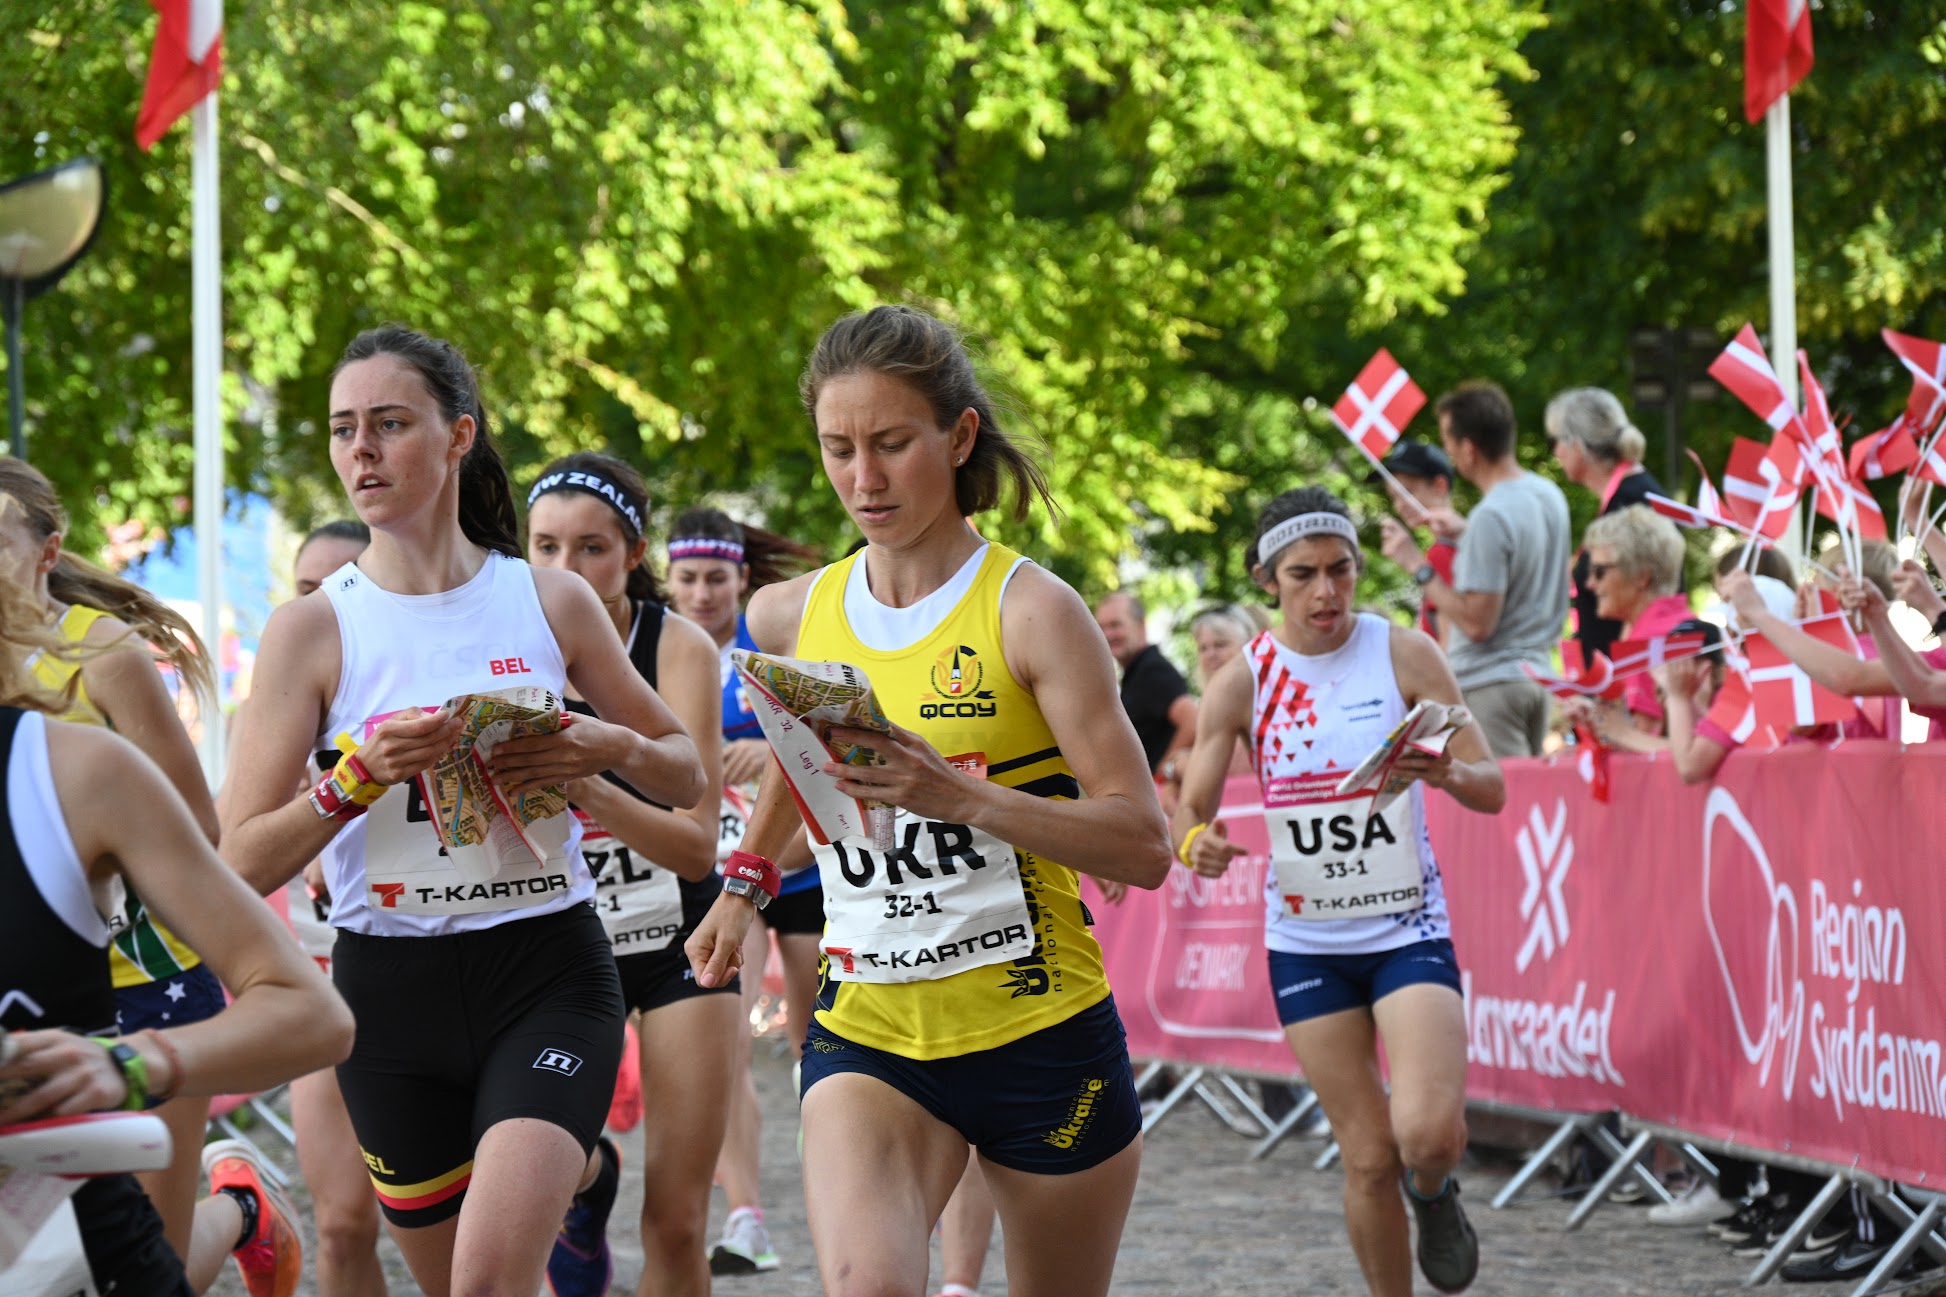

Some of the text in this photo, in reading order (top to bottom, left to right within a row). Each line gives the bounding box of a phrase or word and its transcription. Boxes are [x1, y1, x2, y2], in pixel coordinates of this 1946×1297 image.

[566, 471, 642, 535] ZEALAN
[490, 657, 531, 675] BEL
[920, 702, 997, 720] QCOY
[780, 719, 793, 733] 32
[799, 750, 815, 770] Leg
[1286, 812, 1396, 856] USA
[582, 847, 652, 888] ZL
[832, 821, 986, 888] UKR
[1323, 859, 1369, 879] 33-1
[416, 874, 567, 904] T-KARTOR
[1311, 886, 1420, 911] T-KARTOR
[883, 890, 943, 919] 32-1
[613, 923, 679, 946] RTOR
[862, 923, 1028, 969] T-KARTOR
[1039, 905, 1063, 993] national
[1810, 878, 1906, 1003] Region
